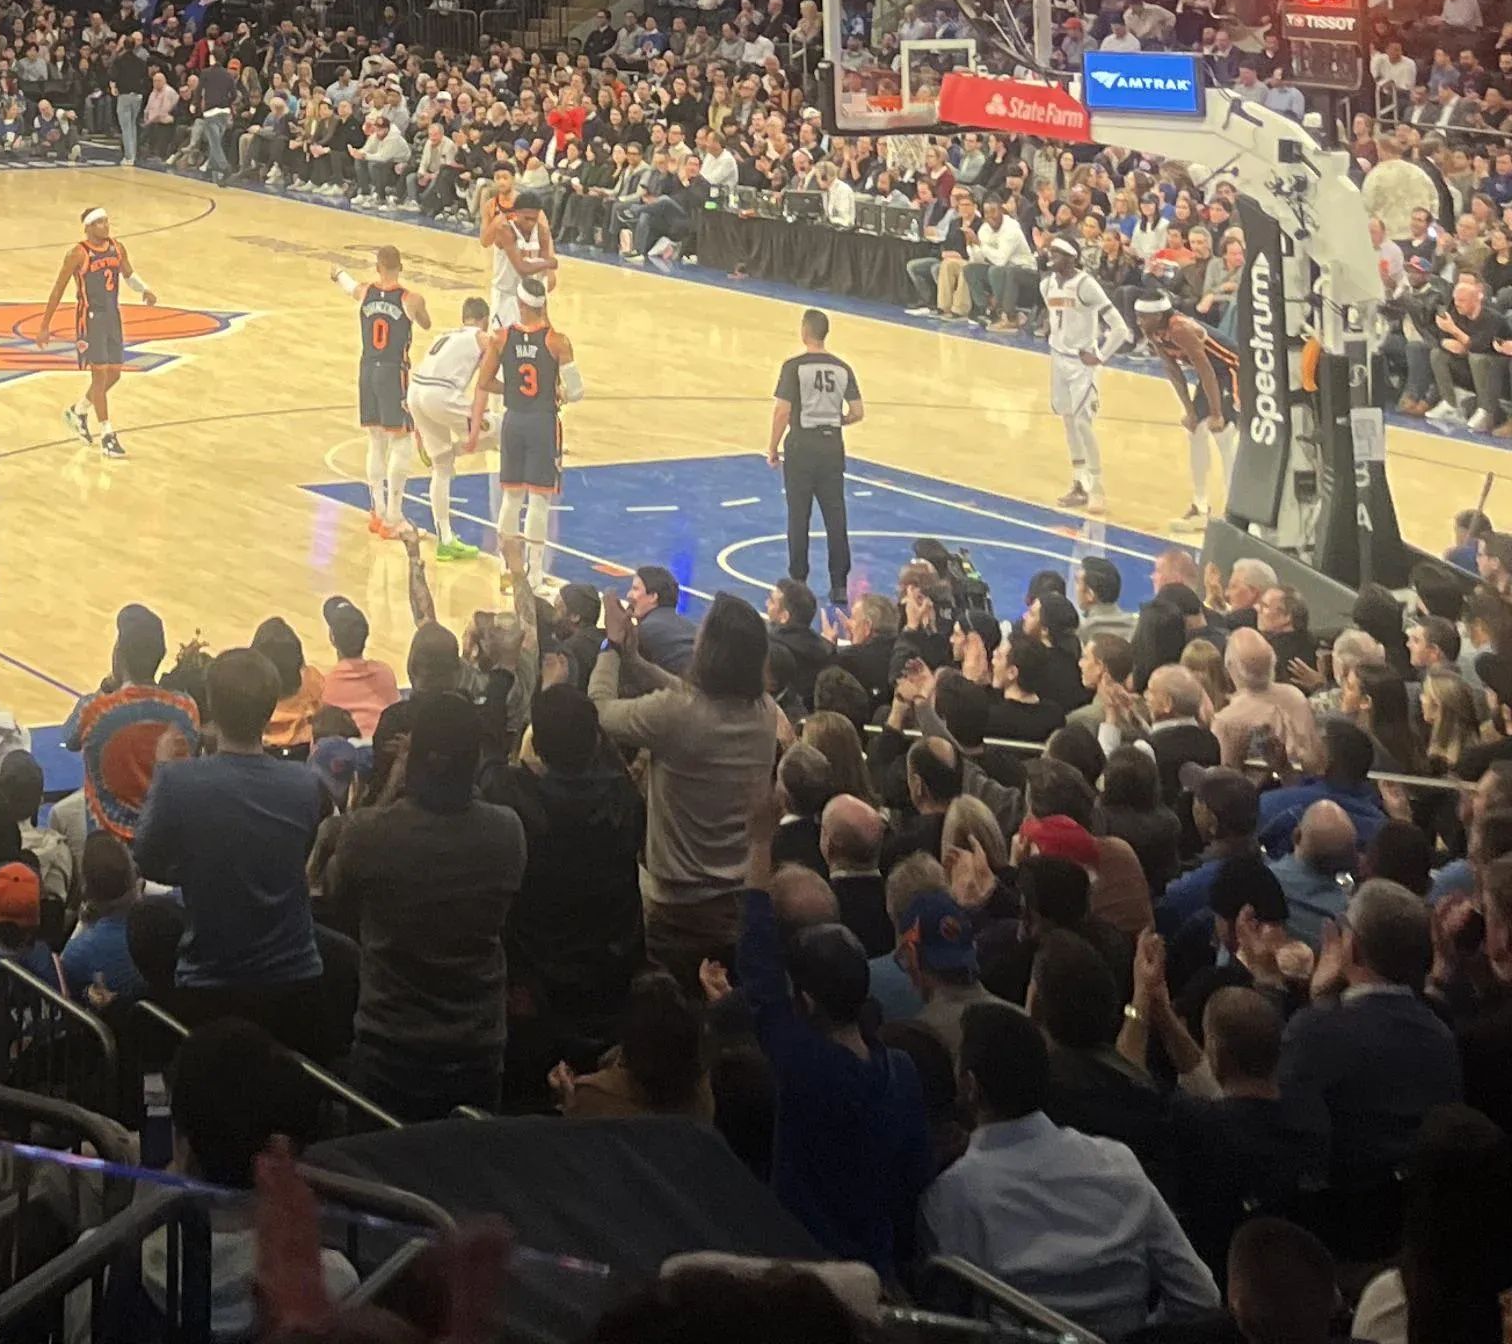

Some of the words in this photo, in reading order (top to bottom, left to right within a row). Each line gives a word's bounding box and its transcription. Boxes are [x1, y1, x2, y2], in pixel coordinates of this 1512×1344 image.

[1305, 15, 1356, 31] TISSOT
[1117, 76, 1191, 91] AMTRAK
[1009, 96, 1045, 122] State
[1045, 103, 1084, 128] Farm
[372, 318, 389, 351] 0
[1250, 269, 1285, 446] Spectrum
[518, 363, 538, 397] 3
[814, 370, 836, 393] 45
